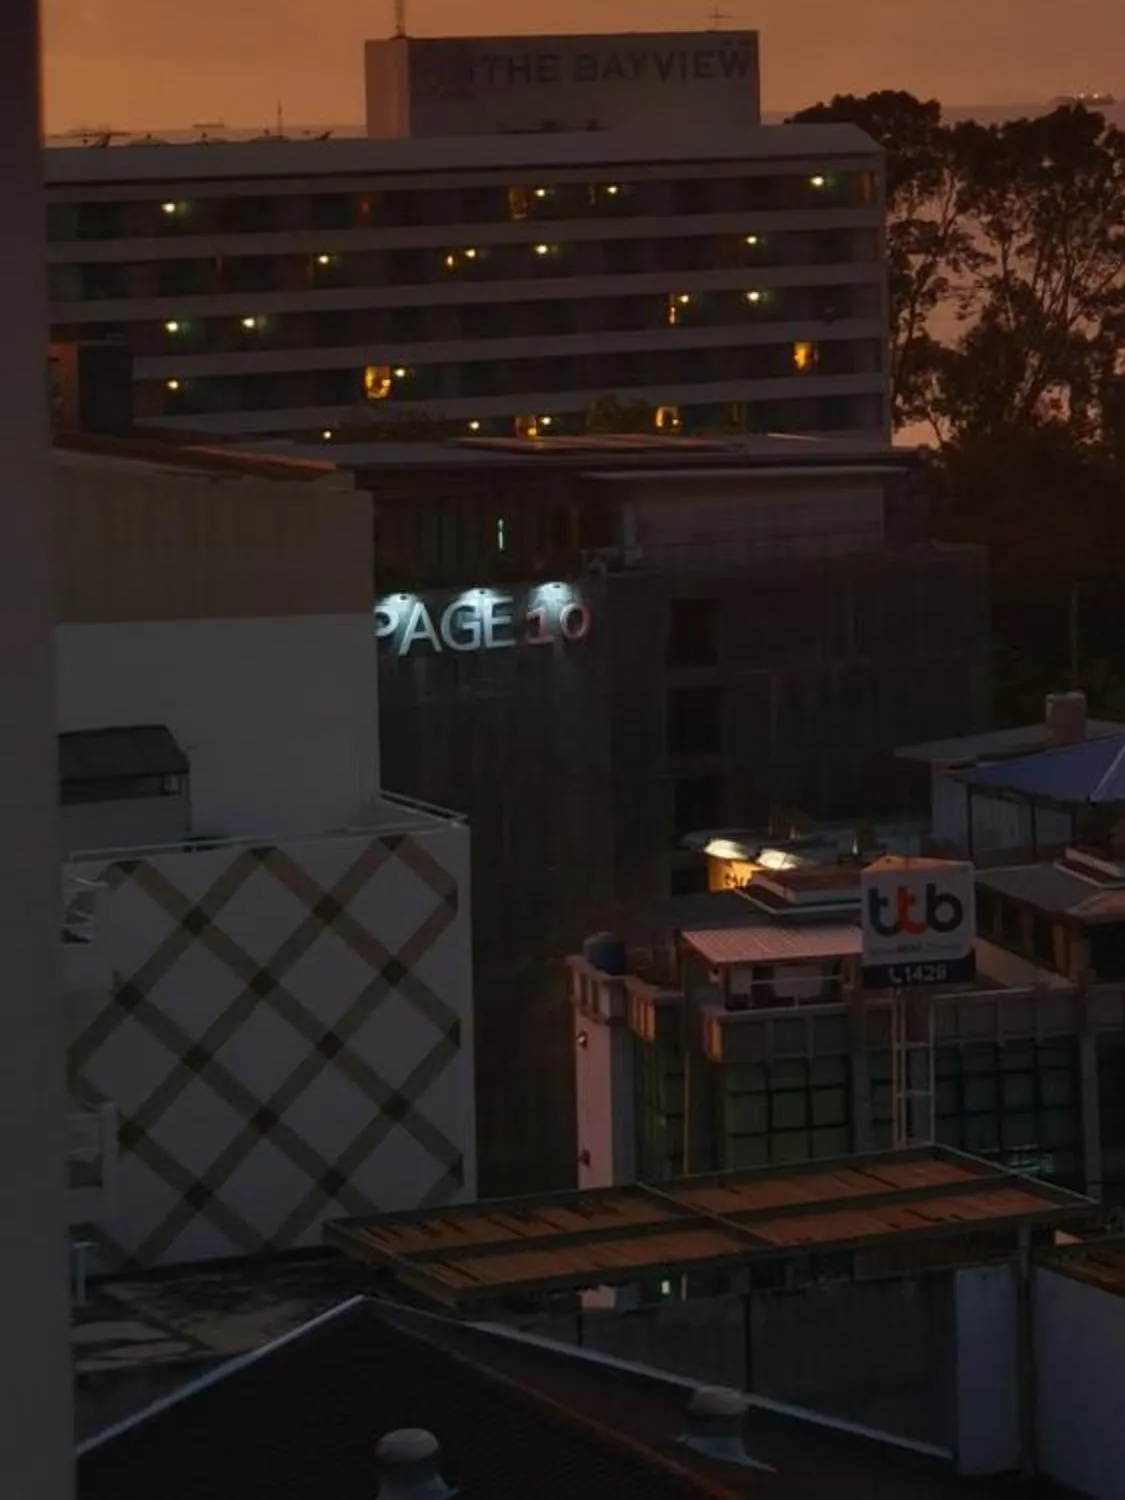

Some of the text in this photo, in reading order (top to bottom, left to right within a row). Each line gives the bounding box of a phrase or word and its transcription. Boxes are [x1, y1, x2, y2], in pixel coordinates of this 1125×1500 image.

[482, 50, 752, 85] THE BAYVIEW
[374, 597, 592, 656] PAGE 10
[868, 884, 963, 937] ttb
